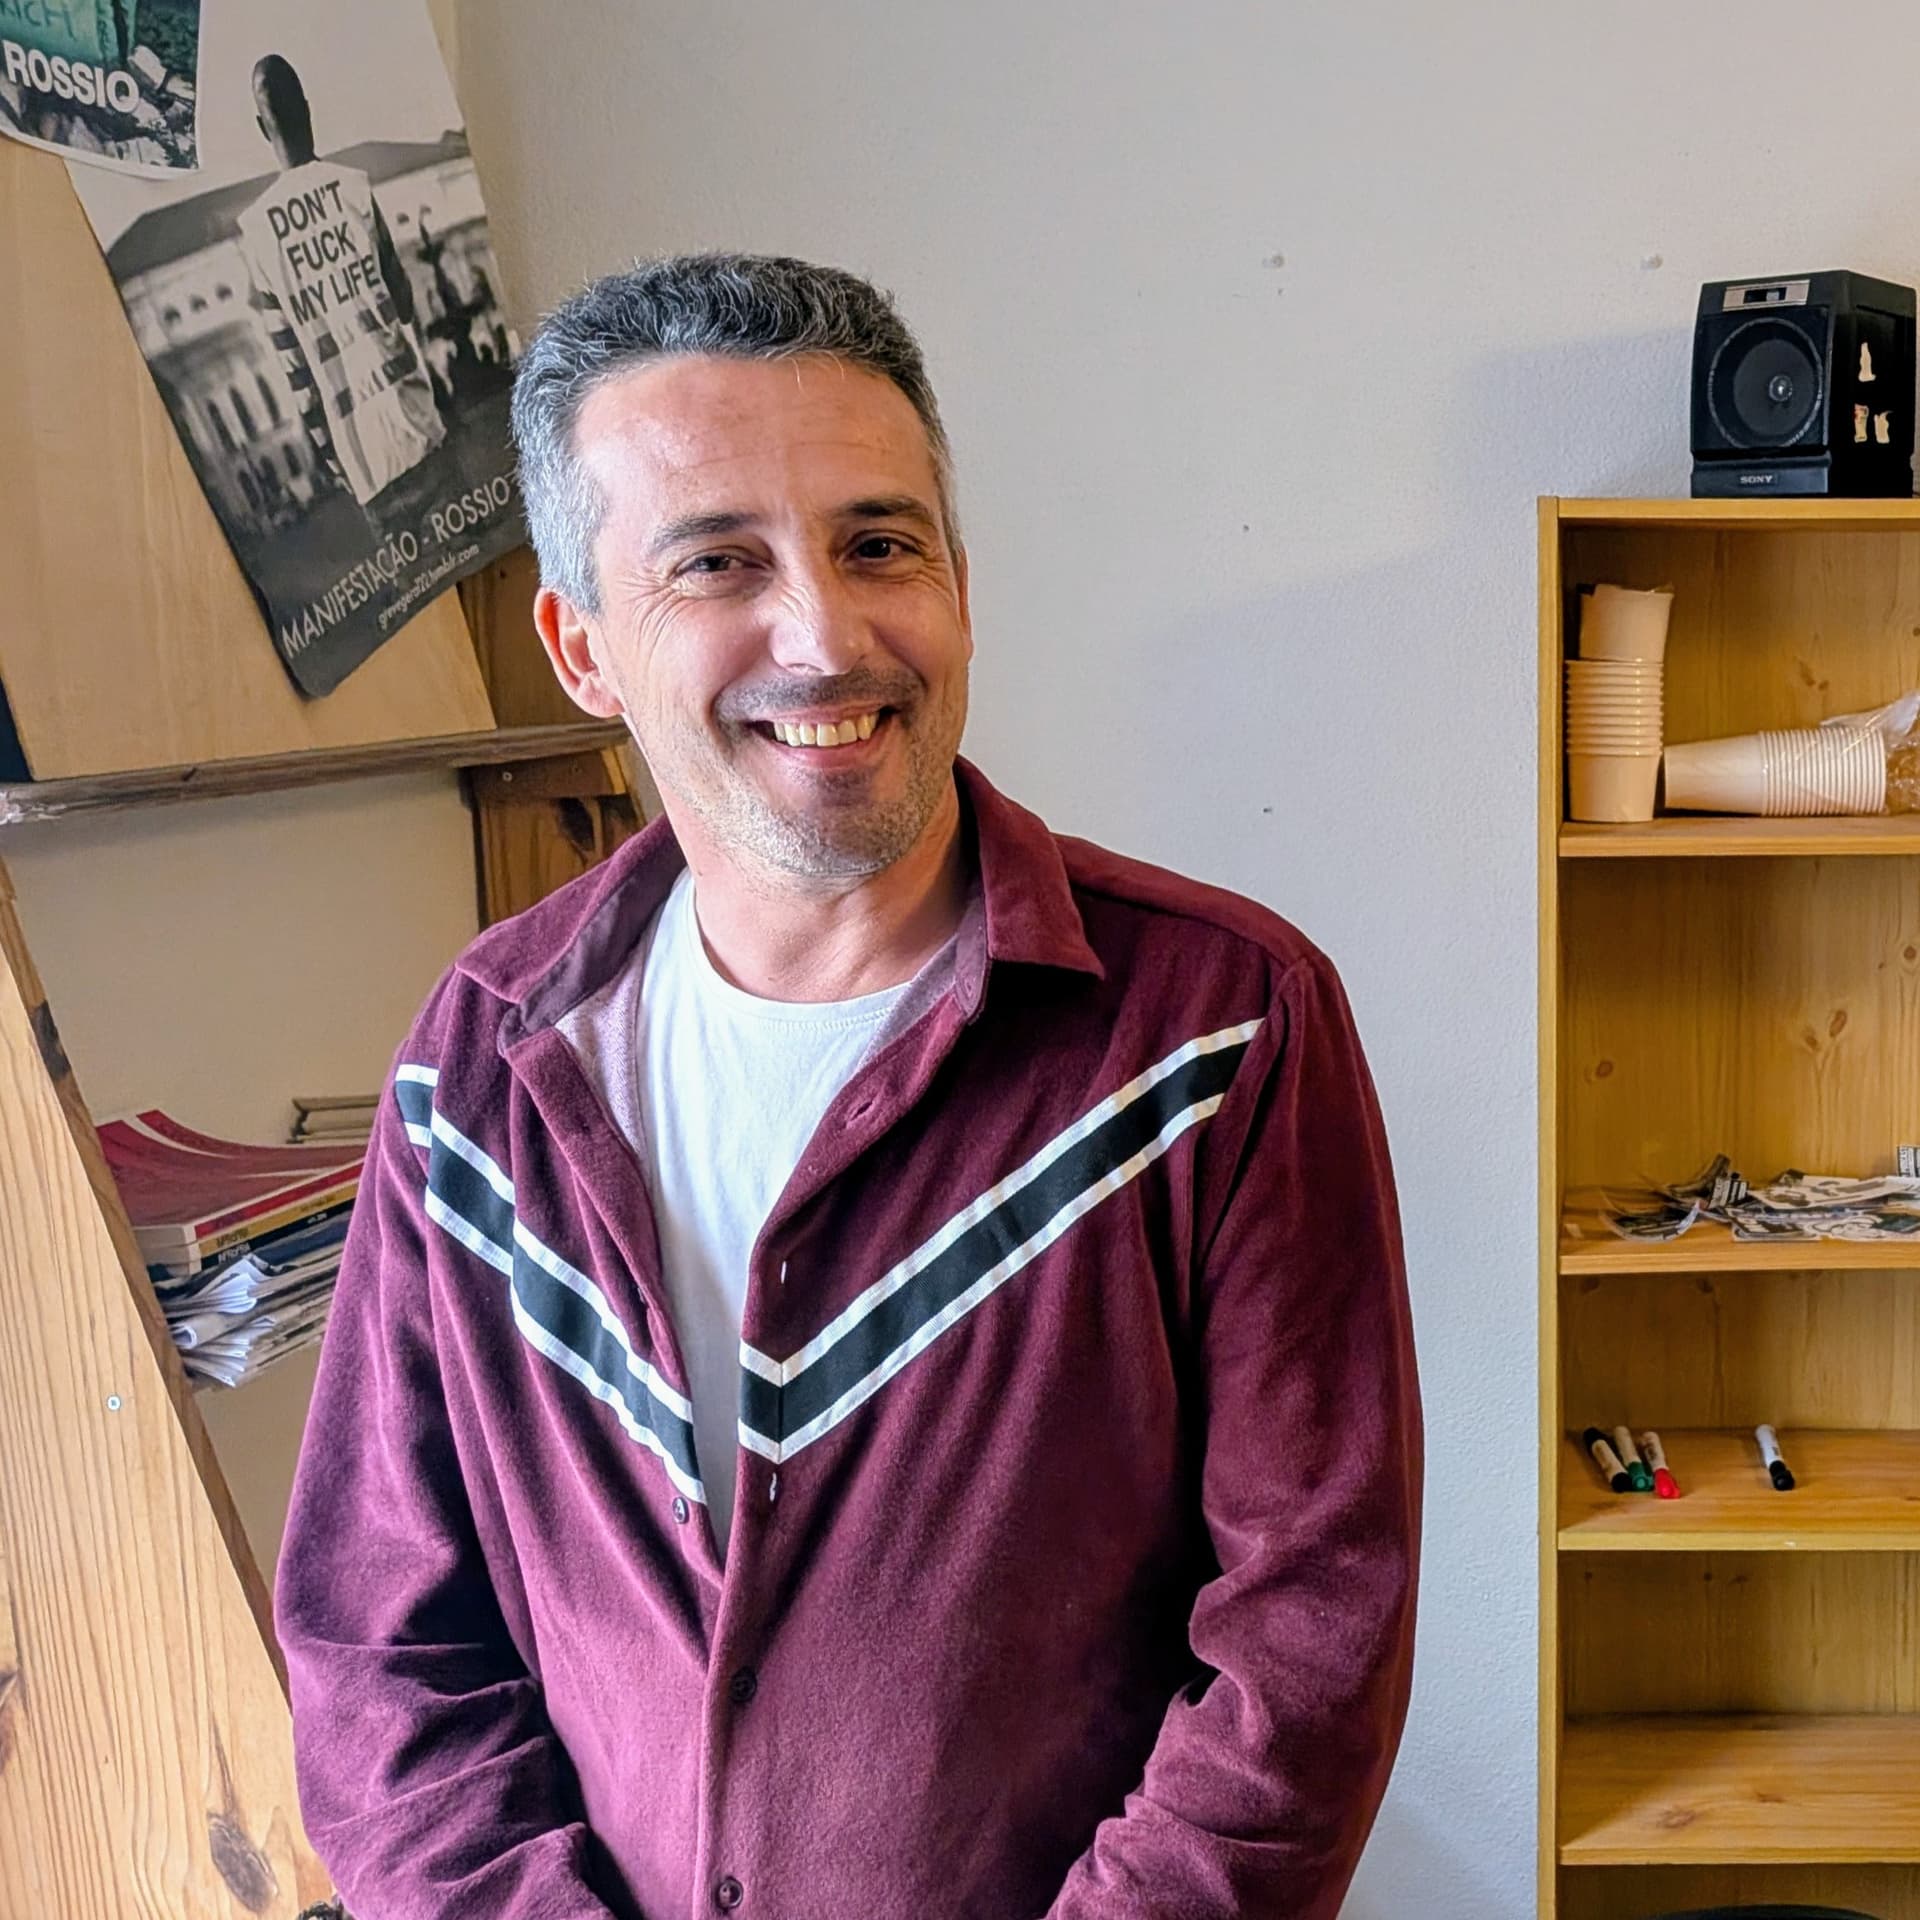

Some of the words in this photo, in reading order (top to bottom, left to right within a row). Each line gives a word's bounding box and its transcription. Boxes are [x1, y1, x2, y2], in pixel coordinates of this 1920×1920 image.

[3, 40, 139, 113] ROSSIO
[266, 180, 343, 241] DON'T
[286, 221, 356, 280] FUCK
[288, 280, 328, 326] MY
[329, 254, 381, 304] LIFE
[1740, 475, 1773, 484] SONY
[281, 531, 418, 659] MANIFESTAÇÃO
[431, 476, 510, 543] ROSSIO
